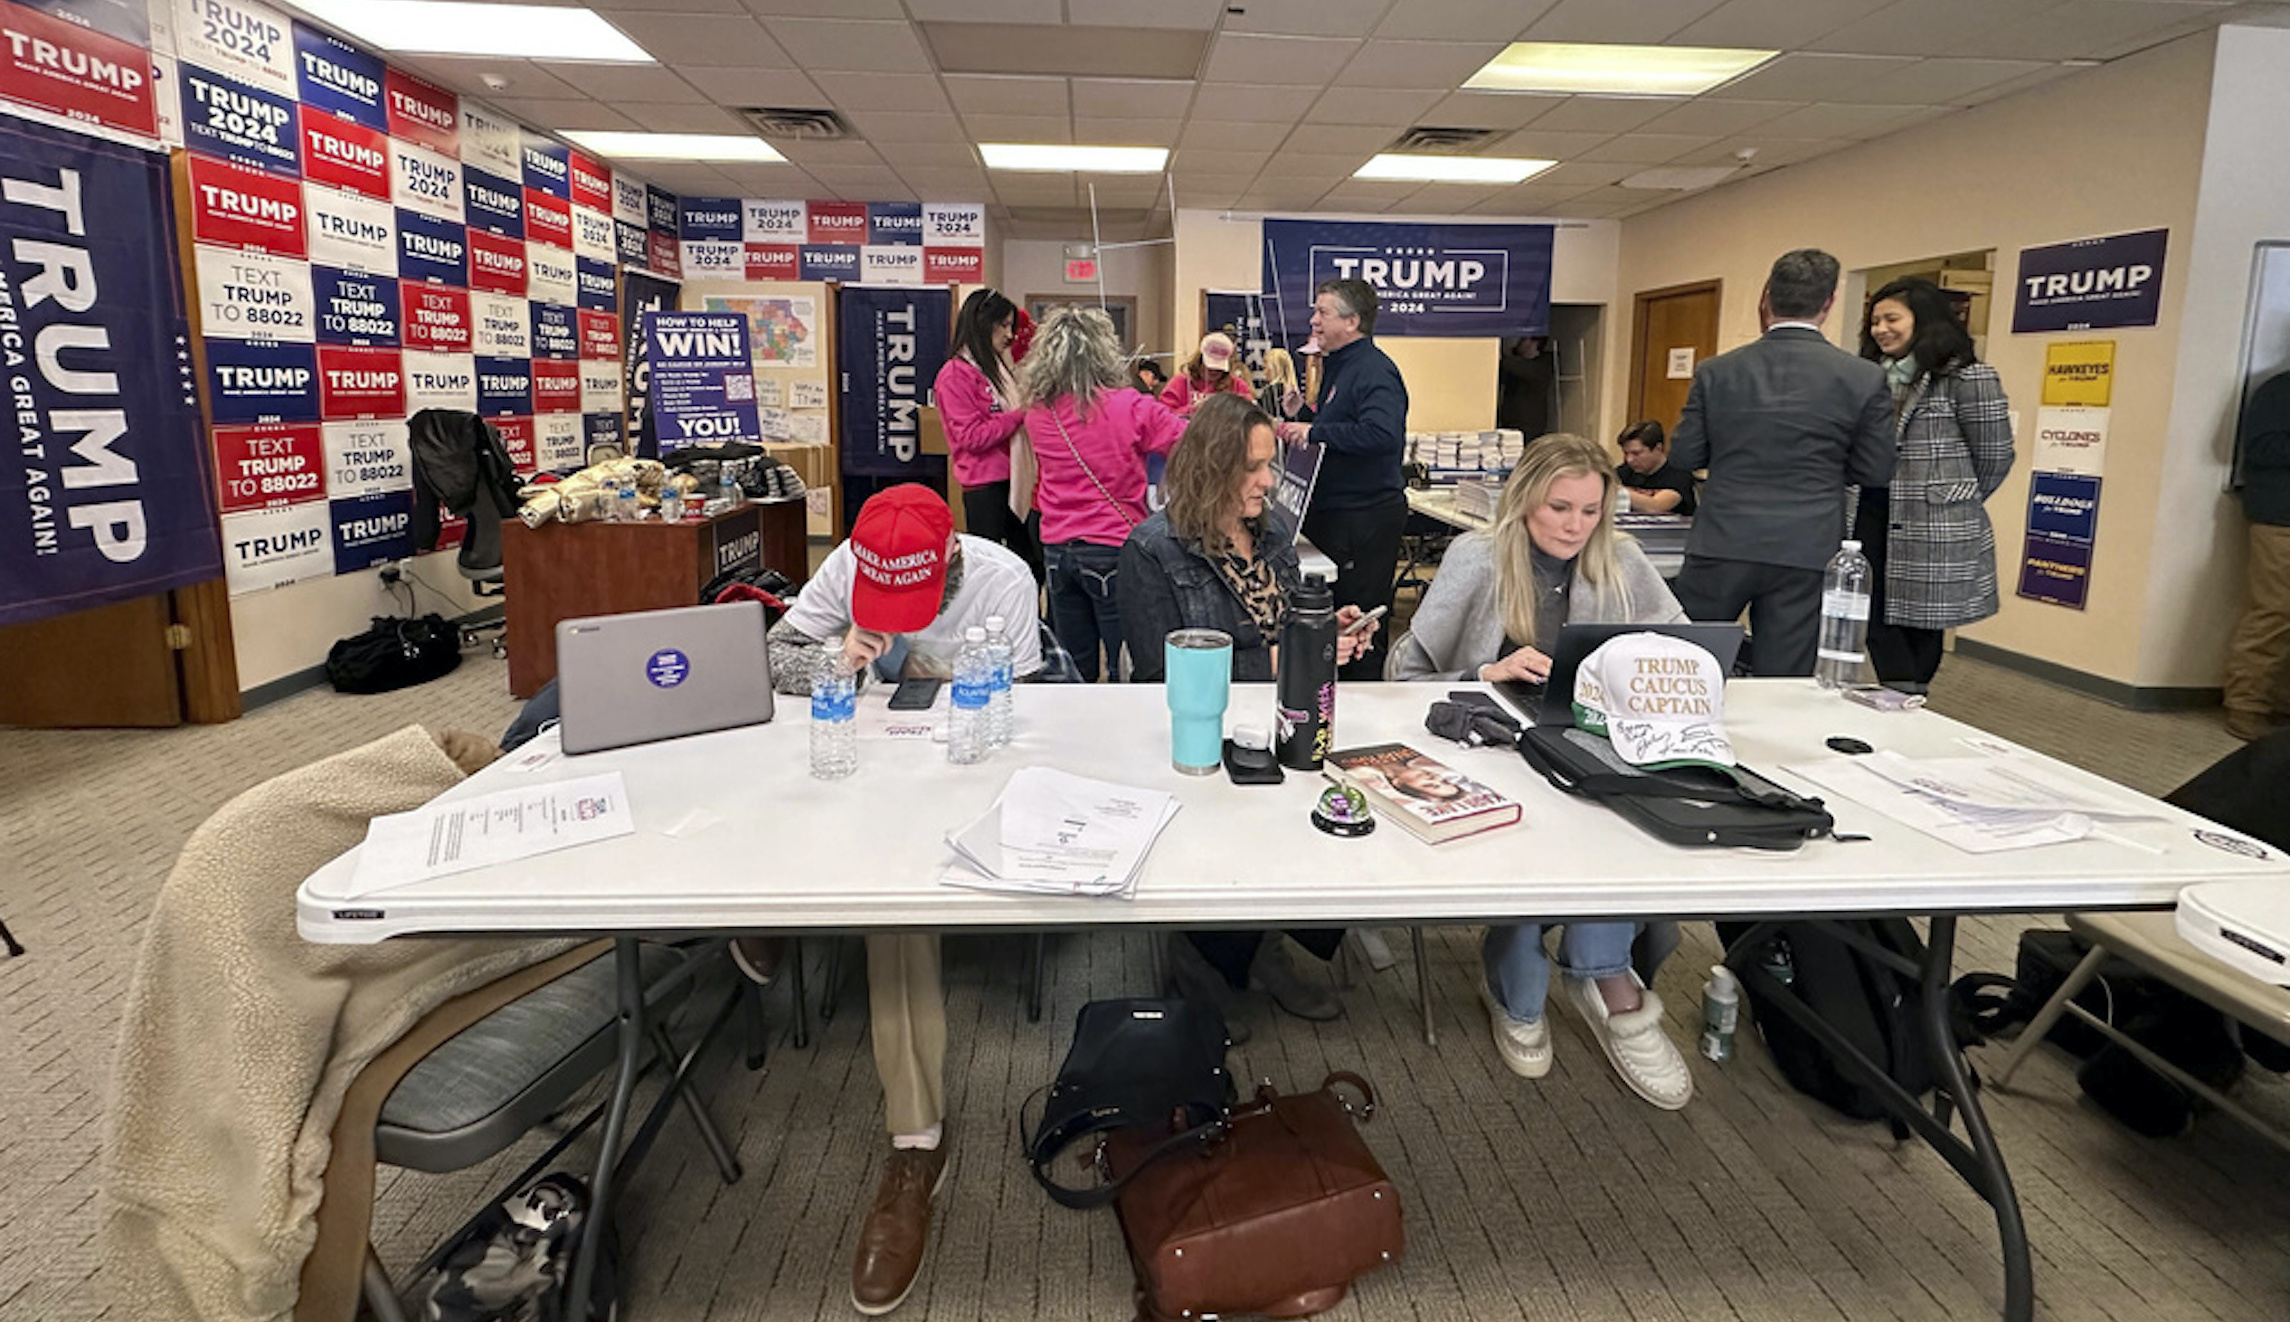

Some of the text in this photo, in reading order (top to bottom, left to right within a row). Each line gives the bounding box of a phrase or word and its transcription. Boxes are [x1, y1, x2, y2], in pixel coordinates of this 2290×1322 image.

[203, 20, 271, 62] 2024
[2, 28, 142, 91] TRUMP
[301, 51, 379, 98] TRUMP
[189, 77, 290, 127] TRUMP
[390, 90, 453, 127] TRUMP
[208, 106, 279, 145] 2024
[308, 130, 384, 169] TRUMP
[398, 154, 456, 185] TRUMP
[524, 147, 567, 175] TRUMP
[409, 175, 449, 199] 2024
[200, 184, 297, 222] TRUMP
[467, 184, 520, 212] TRUMP
[527, 203, 569, 227] TRUMP
[576, 212, 610, 231] TRUMP
[685, 211, 739, 223] TRUMP
[749, 208, 800, 218] TRUMP
[811, 215, 864, 227] TRUMP
[928, 212, 978, 222] TRUMP
[316, 212, 388, 242] TRUMP
[757, 219, 793, 228] 2024
[935, 223, 971, 232] 2024
[401, 231, 463, 259] TRUMP
[686, 245, 739, 255] TRUMP
[473, 248, 523, 272] TRUMP
[695, 255, 731, 265] 2024
[744, 251, 795, 263] TRUMP
[804, 252, 856, 264] TRUMP
[867, 254, 917, 265] TRUMP
[928, 254, 979, 266] TRUMP
[230, 265, 282, 287] TEXT
[533, 260, 573, 281] TRUMP
[1333, 258, 1485, 290] TRUMP
[336, 280, 377, 300] TEXT
[2025, 264, 2152, 298] TRUMP
[224, 285, 292, 306] TRUMP
[421, 294, 454, 310] TEXT
[1377, 291, 1410, 299] MERICA
[211, 303, 304, 327] TO 88022
[330, 297, 386, 318] TRUMP
[415, 309, 460, 326] TRUMP
[488, 304, 513, 318] TEXT
[1389, 302, 1426, 313] 2024
[322, 315, 345, 332] TO
[484, 317, 519, 332] TRUMP
[538, 323, 570, 338] TRUMP
[656, 317, 738, 327] HOW TO HELP
[409, 323, 469, 342] TO 88022
[478, 331, 493, 345] TO
[656, 332, 742, 357] WIN!
[1, 167, 148, 563] TRUMP
[2048, 364, 2109, 375] HAWKEYES
[215, 366, 311, 388] TRUMP
[327, 370, 399, 389] TRUMP
[412, 373, 470, 390] TRUMP
[480, 375, 529, 391] TRUMP
[536, 377, 578, 391] TRUMP
[585, 377, 618, 390] TRUMP
[887, 302, 916, 462] TRUMP
[0, 271, 59, 556] ERICA GREAT AGAIN!
[549, 423, 571, 434] TEXT
[677, 417, 741, 437] YOU!
[2041, 429, 2101, 443] CYCLONES
[246, 436, 294, 456] TEXT
[348, 433, 386, 448] TEXT
[546, 436, 575, 447] TRUMP
[238, 455, 306, 477] TRUMP
[342, 449, 394, 466] TRUMP
[334, 465, 403, 485] TO 88022
[228, 474, 318, 497] TO 88022
[339, 513, 409, 541] TRUMP
[234, 529, 322, 560] TRUMP
[719, 531, 759, 565] TRUMP
[853, 540, 939, 572] MAKE AMERICA
[893, 566, 932, 587] AGAIN
[1635, 657, 1700, 675] TRUMP
[1629, 677, 1707, 695] CAUCUS
[1628, 697, 1712, 714] CAPTAIN
